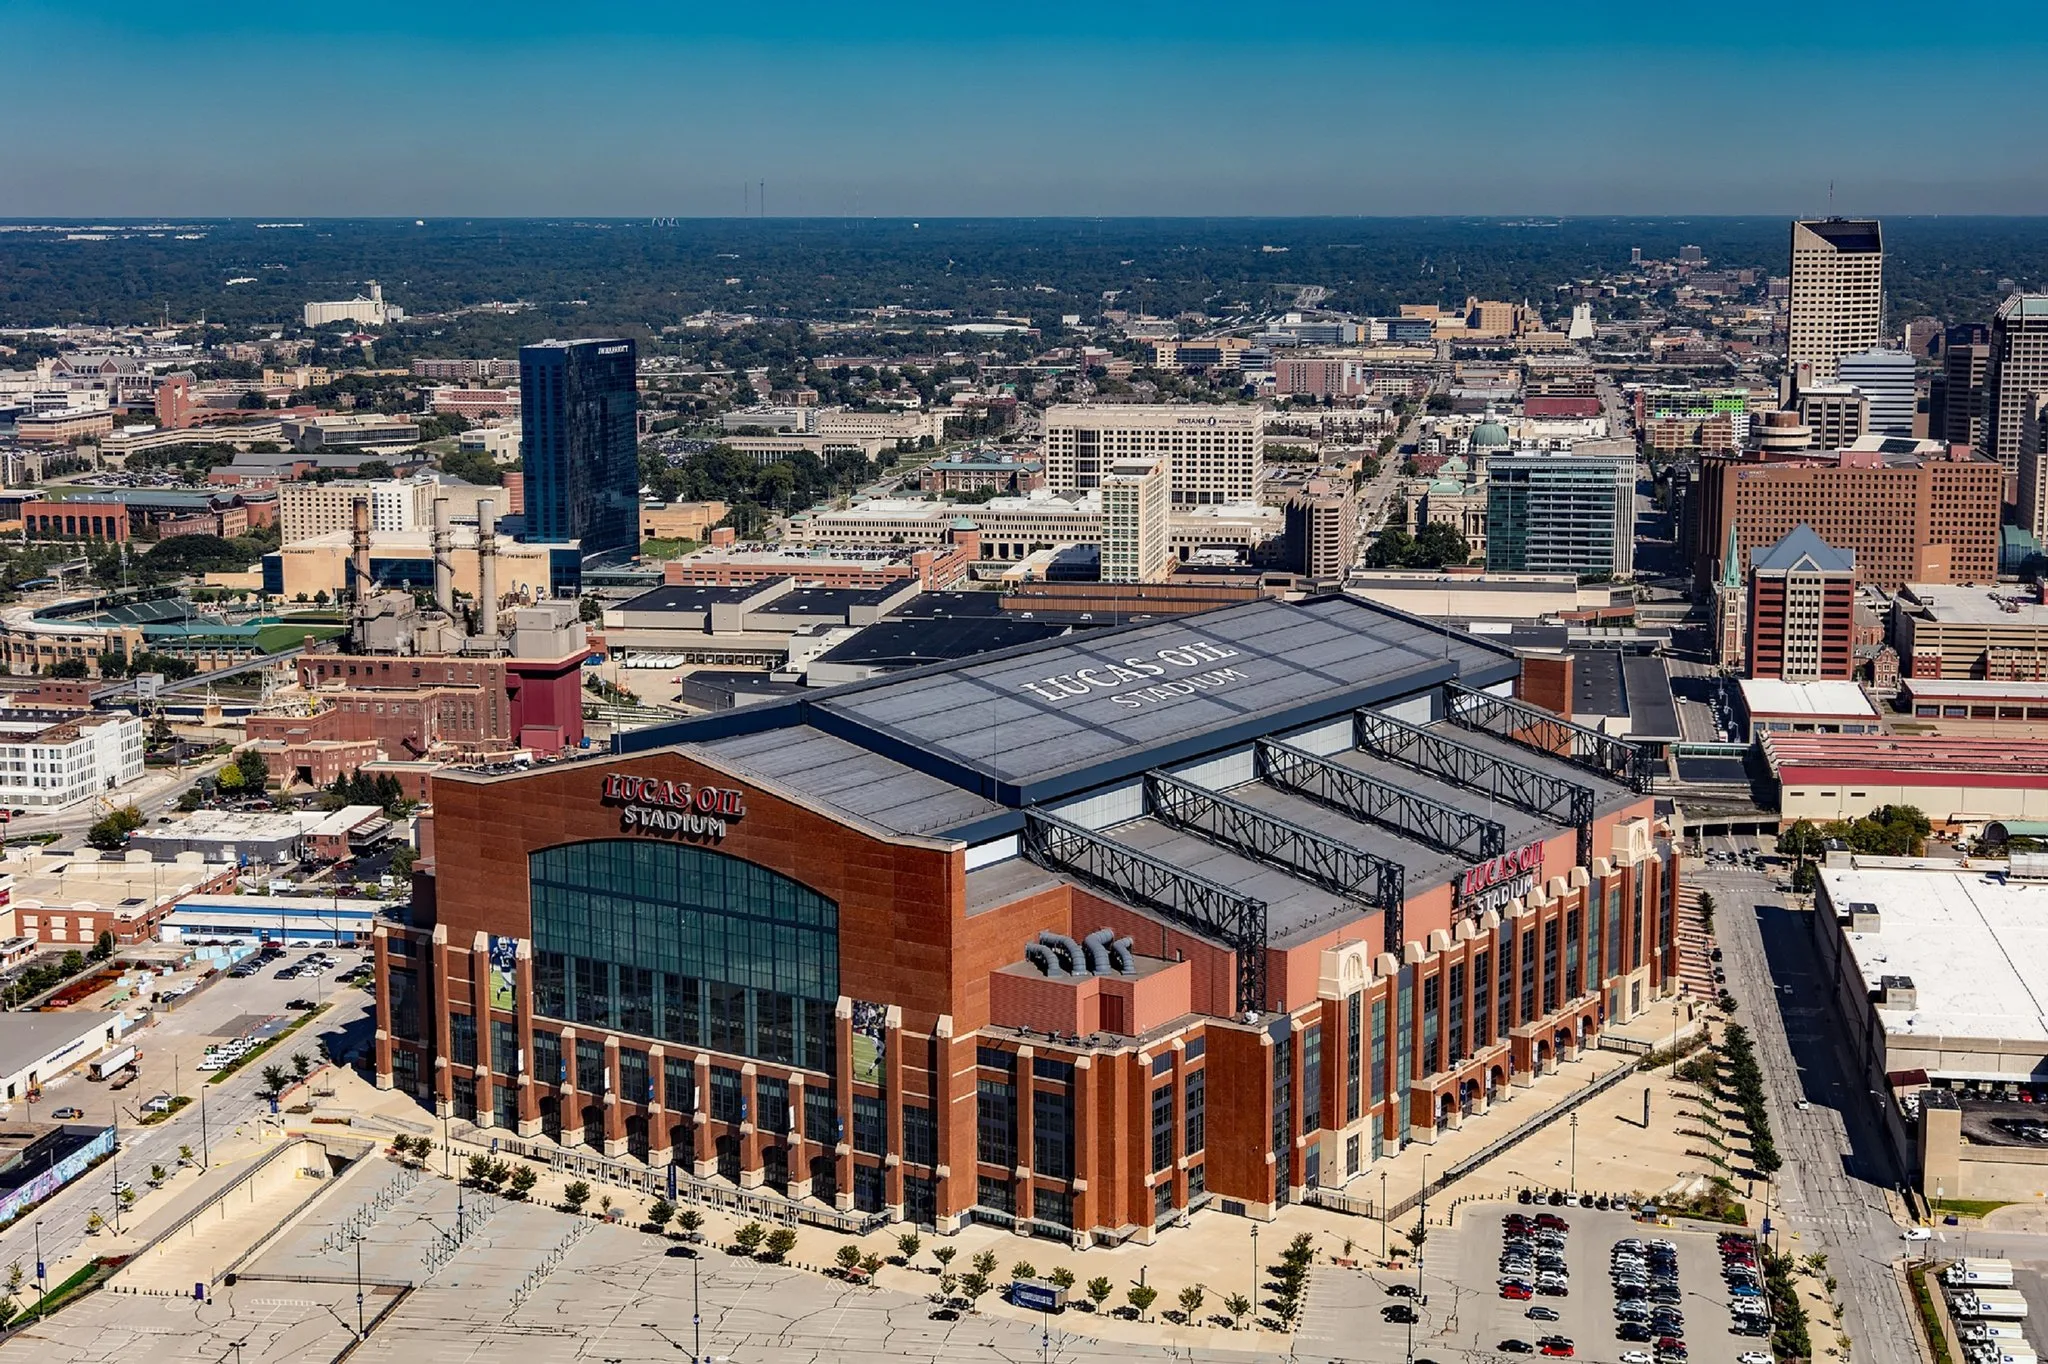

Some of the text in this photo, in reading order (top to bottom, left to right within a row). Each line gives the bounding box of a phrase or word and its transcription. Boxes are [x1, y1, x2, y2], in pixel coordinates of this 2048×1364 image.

[1018, 642, 1240, 702] LUCAS OIL
[1109, 667, 1250, 709] STADIUM
[604, 773, 747, 816] LUCAS OIL
[624, 805, 727, 837] STADIUM
[1464, 840, 1545, 896] LUCAS OIL
[1477, 875, 1534, 915] STADIUM
